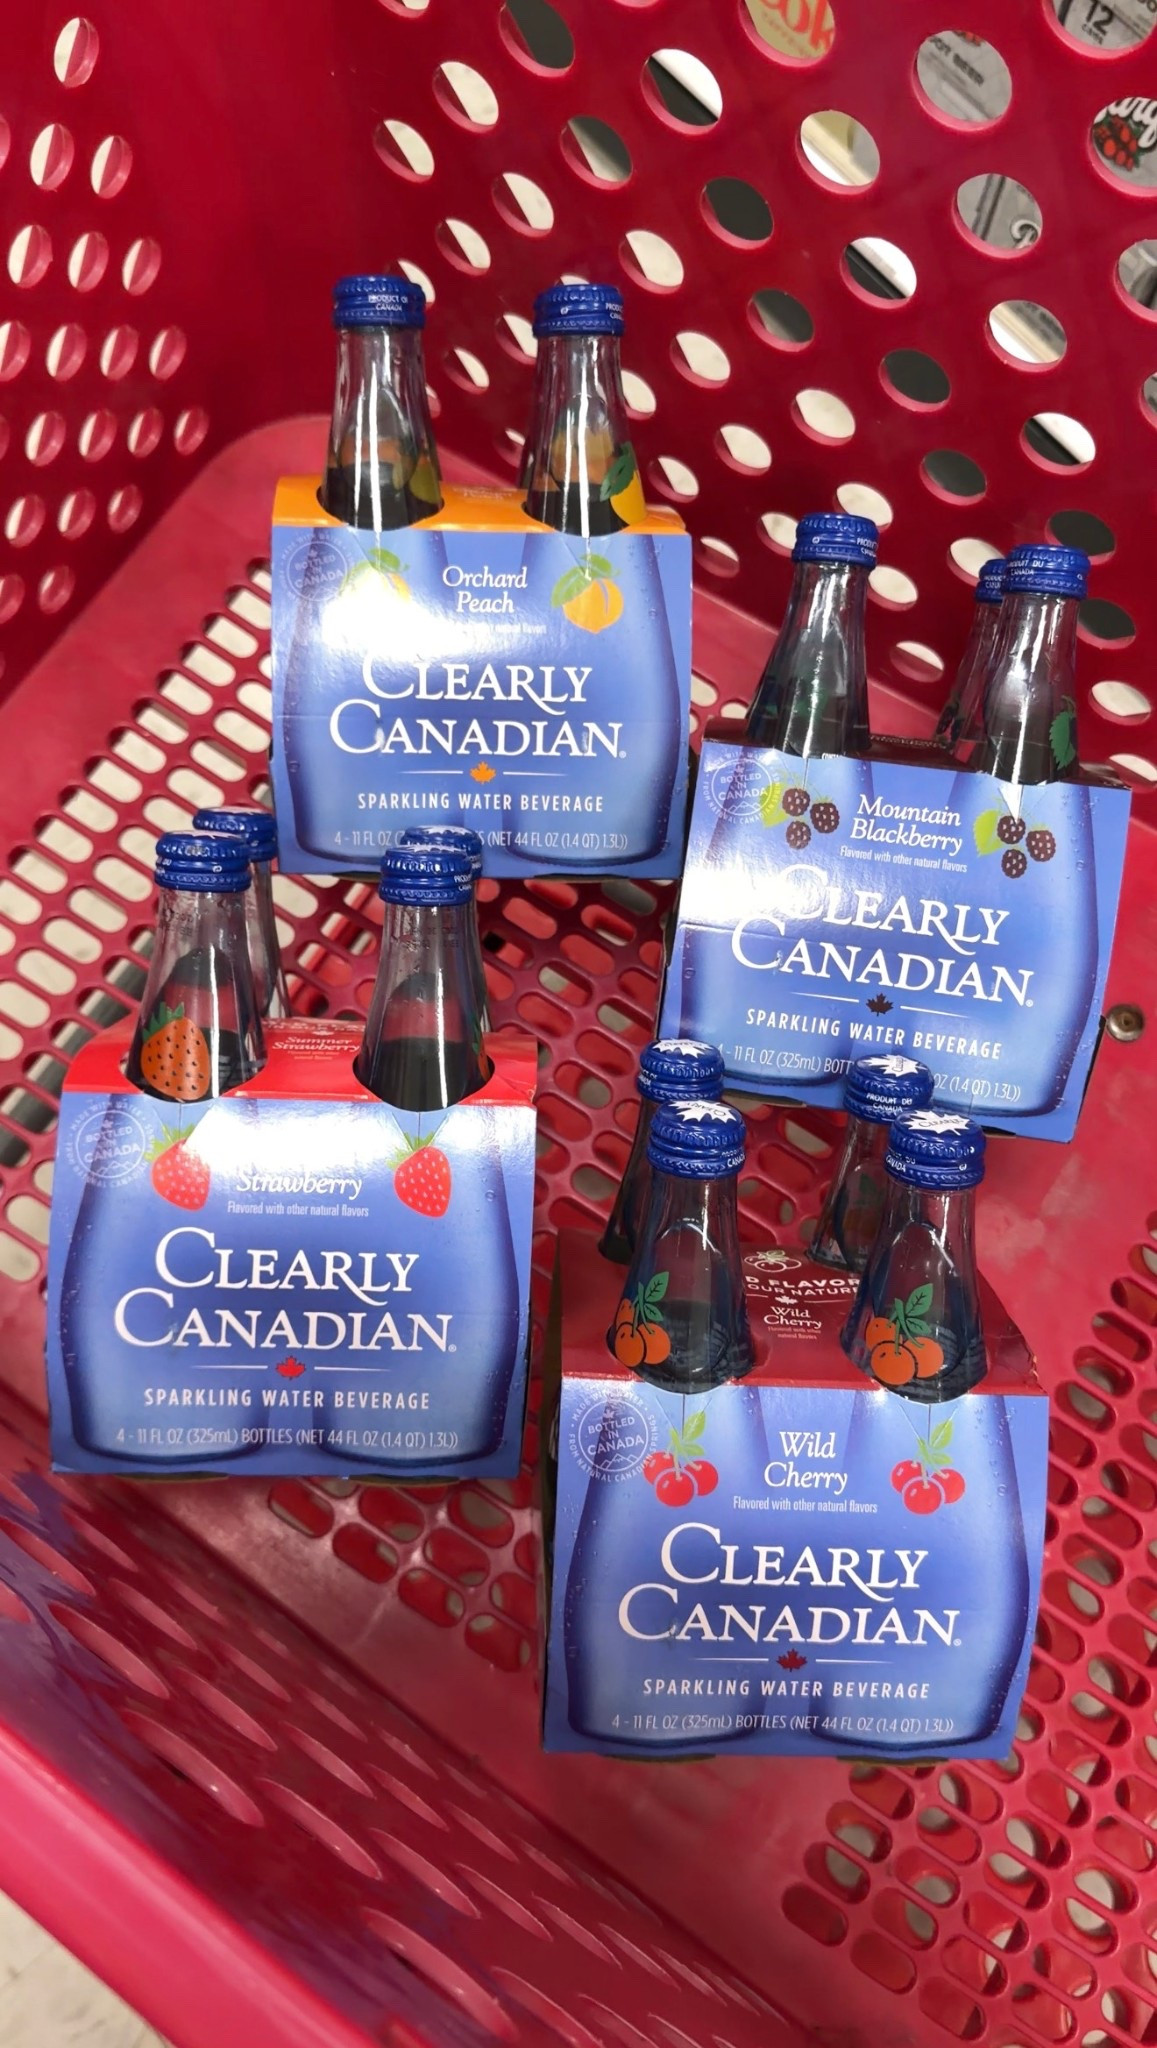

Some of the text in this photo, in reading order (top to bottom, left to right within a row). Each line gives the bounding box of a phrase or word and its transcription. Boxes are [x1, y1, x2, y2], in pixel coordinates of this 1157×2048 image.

[1084, 0, 1114, 36] 12
[368, 294, 399, 304] PRODUCT
[1032, 560, 1044, 568] DU
[294, 569, 343, 589] CANADA
[442, 565, 528, 588] Orchard
[456, 591, 515, 613] Peach
[362, 652, 592, 715] CLEARLY
[720, 772, 762, 784] BOTTLED
[358, 793, 603, 812] SPARKLING WATER BEVERAGE
[718, 787, 768, 801] CANADA
[857, 794, 961, 827] Mountain
[334, 830, 341, 846] 4
[352, 830, 360, 846] 11
[364, 830, 375, 846] FL
[378, 830, 392, 846] OZ
[487, 831, 512, 848] (NET
[514, 832, 529, 846] 44
[531, 832, 542, 847] FL
[545, 832, 559, 847] OZ
[561, 831, 579, 849] (1.4
[581, 833, 599, 849] QT)
[850, 817, 963, 857] Blackberry
[840, 845, 968, 873] Flavored with other natural flavors
[778, 864, 1010, 956] CLEARLY
[746, 1008, 1003, 1060] SPARKLING WATER BEVERAGE
[272, 1041, 360, 1053] Strawberry
[734, 1045, 742, 1061] 11
[745, 1047, 756, 1063] FL
[760, 1050, 775, 1066] OZ
[777, 1051, 821, 1073] (325mL)
[824, 1058, 854, 1075] BOTT
[934, 1073, 949, 1089] OZ
[950, 1076, 969, 1093] (1.4
[971, 1079, 991, 1098] QT)
[866, 1092, 897, 1104] PRODUIT
[85, 1126, 133, 1143] BOTTLED
[83, 1143, 141, 1163] CANADA
[236, 1171, 362, 1201] Strawberry
[227, 1200, 369, 1217] Flavored with other natural flavors
[155, 1226, 419, 1306] CLEARLY
[764, 1314, 821, 1329] Cherry
[771, 1306, 811, 1318] Wild
[144, 1388, 430, 1409] SPARKLING WATER BEVERAGE
[587, 1416, 635, 1434] BOTTLED
[607, 1430, 619, 1440] IN
[116, 1428, 124, 1443] 4
[138, 1428, 146, 1444] 11
[151, 1428, 163, 1444] FL
[167, 1428, 183, 1444] OZ
[187, 1428, 238, 1446] (325mL)
[241, 1428, 292, 1444] BOTTLES
[296, 1429, 324, 1446] (NET
[327, 1429, 342, 1444] 44
[347, 1430, 358, 1445] FL
[363, 1430, 379, 1446] OZ
[381, 1431, 400, 1448] (1.4
[405, 1431, 426, 1449] QT)
[568, 1433, 579, 1458] FROM
[577, 1458, 612, 1483] NATURAL
[648, 1414, 659, 1453] SPRINGS
[587, 1434, 645, 1456] CANADA
[779, 1431, 836, 1459] Wild
[764, 1461, 848, 1496] Cherry
[733, 1495, 878, 1513] Flavored with other natural flavors
[661, 1522, 928, 1602] CLEARLY
[643, 1678, 930, 1699] SPARKLING WATER BEVERAGE
[611, 1714, 620, 1729] 4
[633, 1715, 642, 1729] 11
[646, 1715, 658, 1730] FL
[662, 1715, 679, 1730] OZ
[682, 1714, 733, 1731] (325mL)
[736, 1714, 787, 1729] BOTTLES
[790, 1715, 819, 1731] (NET
[822, 1716, 837, 1729] 44
[841, 1716, 853, 1731] FL
[857, 1717, 873, 1731] OZ
[876, 1718, 897, 1734] (1.4
[900, 1718, 921, 1734] QT)
